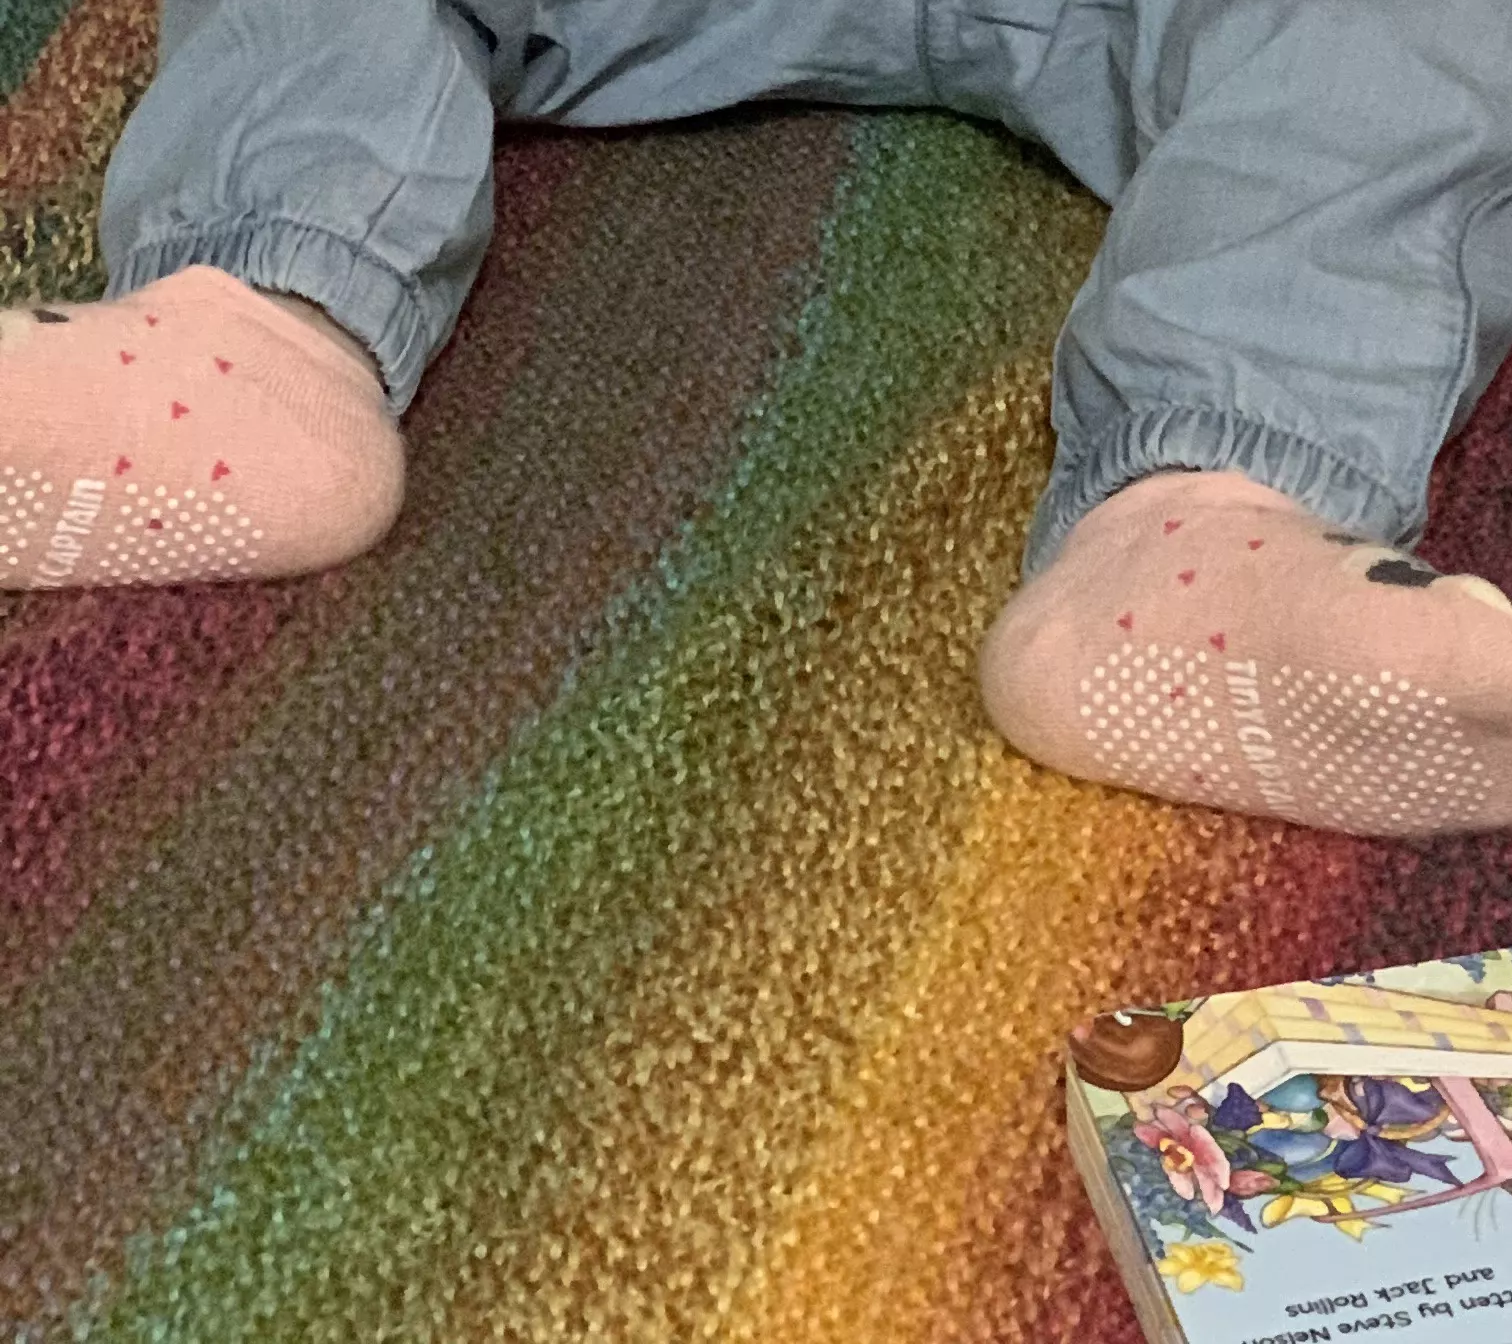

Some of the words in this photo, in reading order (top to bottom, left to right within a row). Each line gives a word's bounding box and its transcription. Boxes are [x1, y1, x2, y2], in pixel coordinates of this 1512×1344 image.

[1373, 1276, 1437, 1304] Jack
[1444, 1265, 1496, 1291] and
[1284, 1291, 1369, 1318] Rollins
[1417, 1300, 1455, 1319] by
[1336, 1309, 1413, 1335] Steve
